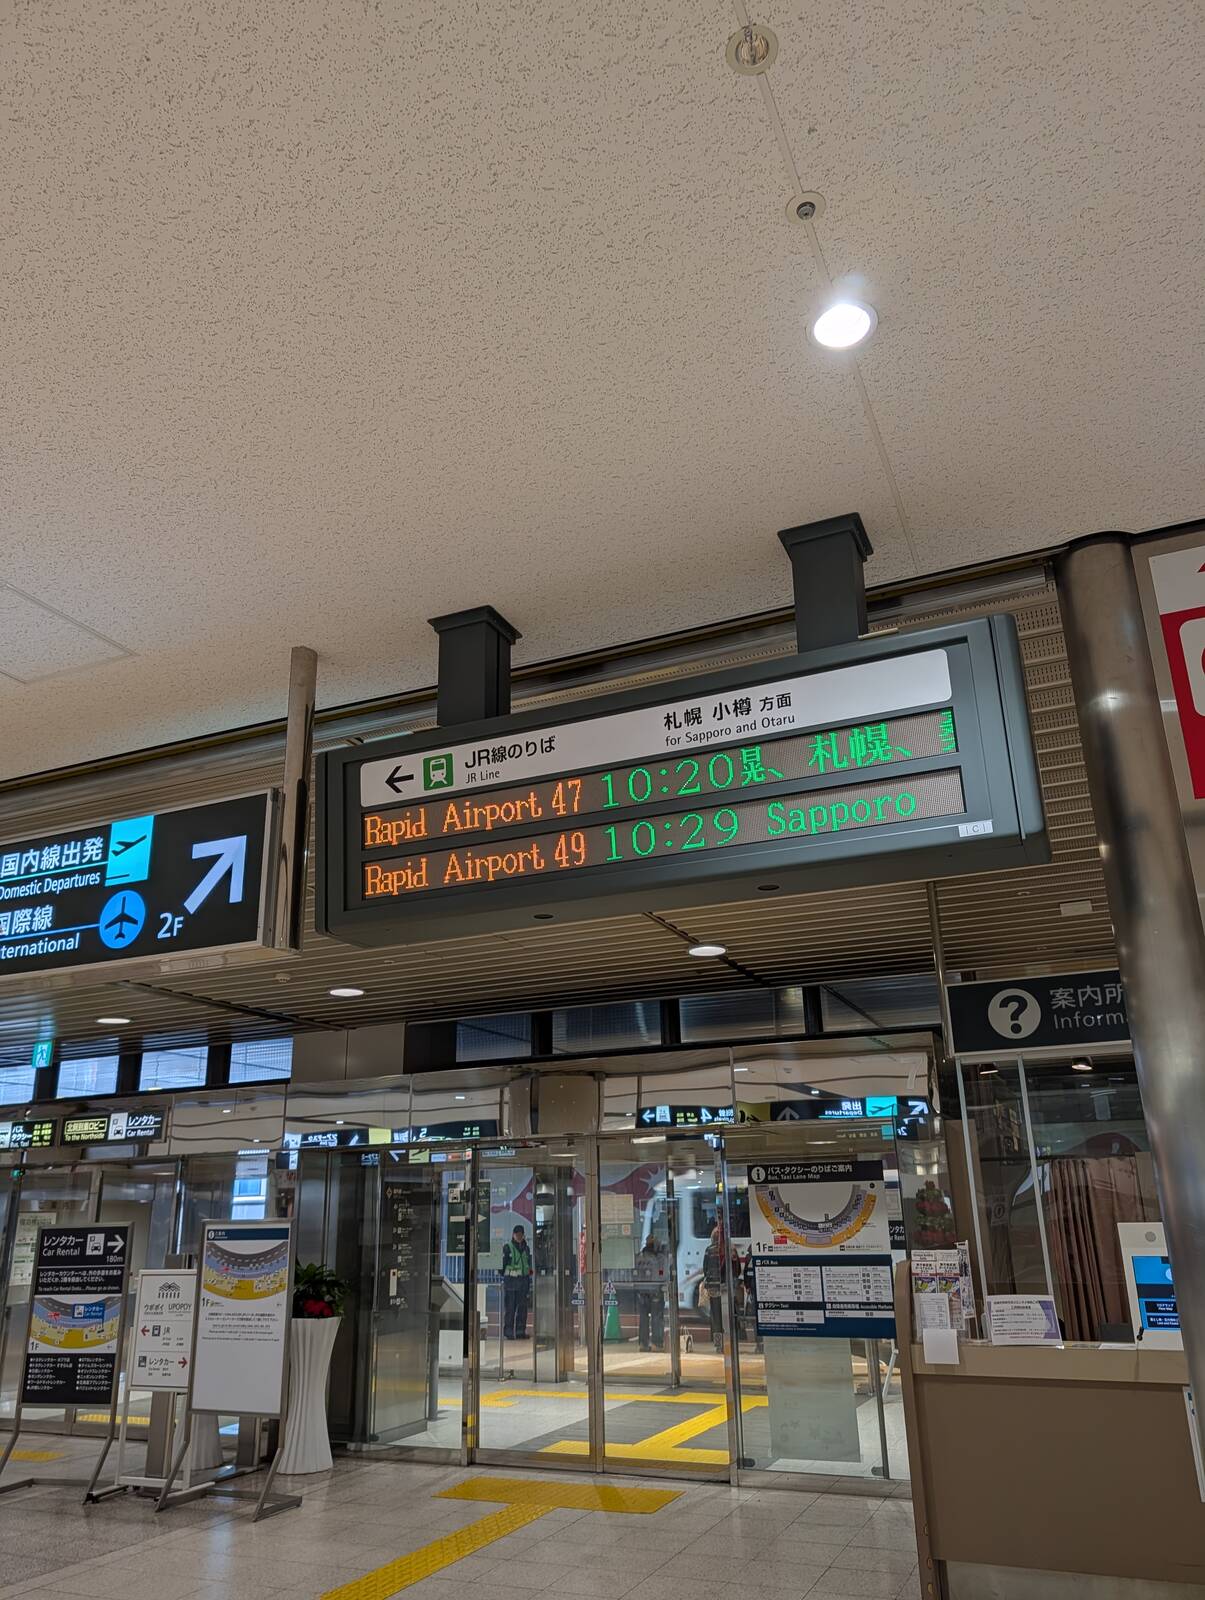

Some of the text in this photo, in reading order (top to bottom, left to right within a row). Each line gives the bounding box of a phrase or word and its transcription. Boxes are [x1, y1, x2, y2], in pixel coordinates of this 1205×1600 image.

[663, 692, 792, 731] 札幌 小樽 方面
[665, 714, 796, 747] for Sapporo and Otaru
[464, 736, 556, 769] JR線のりば
[466, 769, 501, 784] JR Line
[601, 753, 735, 808] 10:20
[364, 778, 583, 846] Rapid Airport 47
[603, 792, 917, 861] 10:29 Sapporo
[0, 836, 104, 879] 国内線出発
[364, 831, 586, 896] Rapid Airport 49
[0, 872, 100, 901] Domestic Departures
[0, 904, 54, 937] 国際線
[156, 911, 184, 939] 2F
[0, 932, 80, 960] ternational
[1054, 1010, 1128, 1030] Inform
[128, 1115, 162, 1127] レンタカー
[11, 1133, 33, 1142] タクシー
[127, 1128, 155, 1137] Car Rental
[767, 1164, 853, 1175] バス・タクシーのりばご案内
[43, 1235, 84, 1247] レンタカー
[756, 1241, 768, 1253] 1F
[42, 1247, 81, 1257] Car Rental
[106, 1255, 124, 1263] 180m
[168, 1303, 192, 1311] UPOPOY
[30, 1341, 39, 1350] 1F
[149, 1358, 175, 1366] レンタカー
